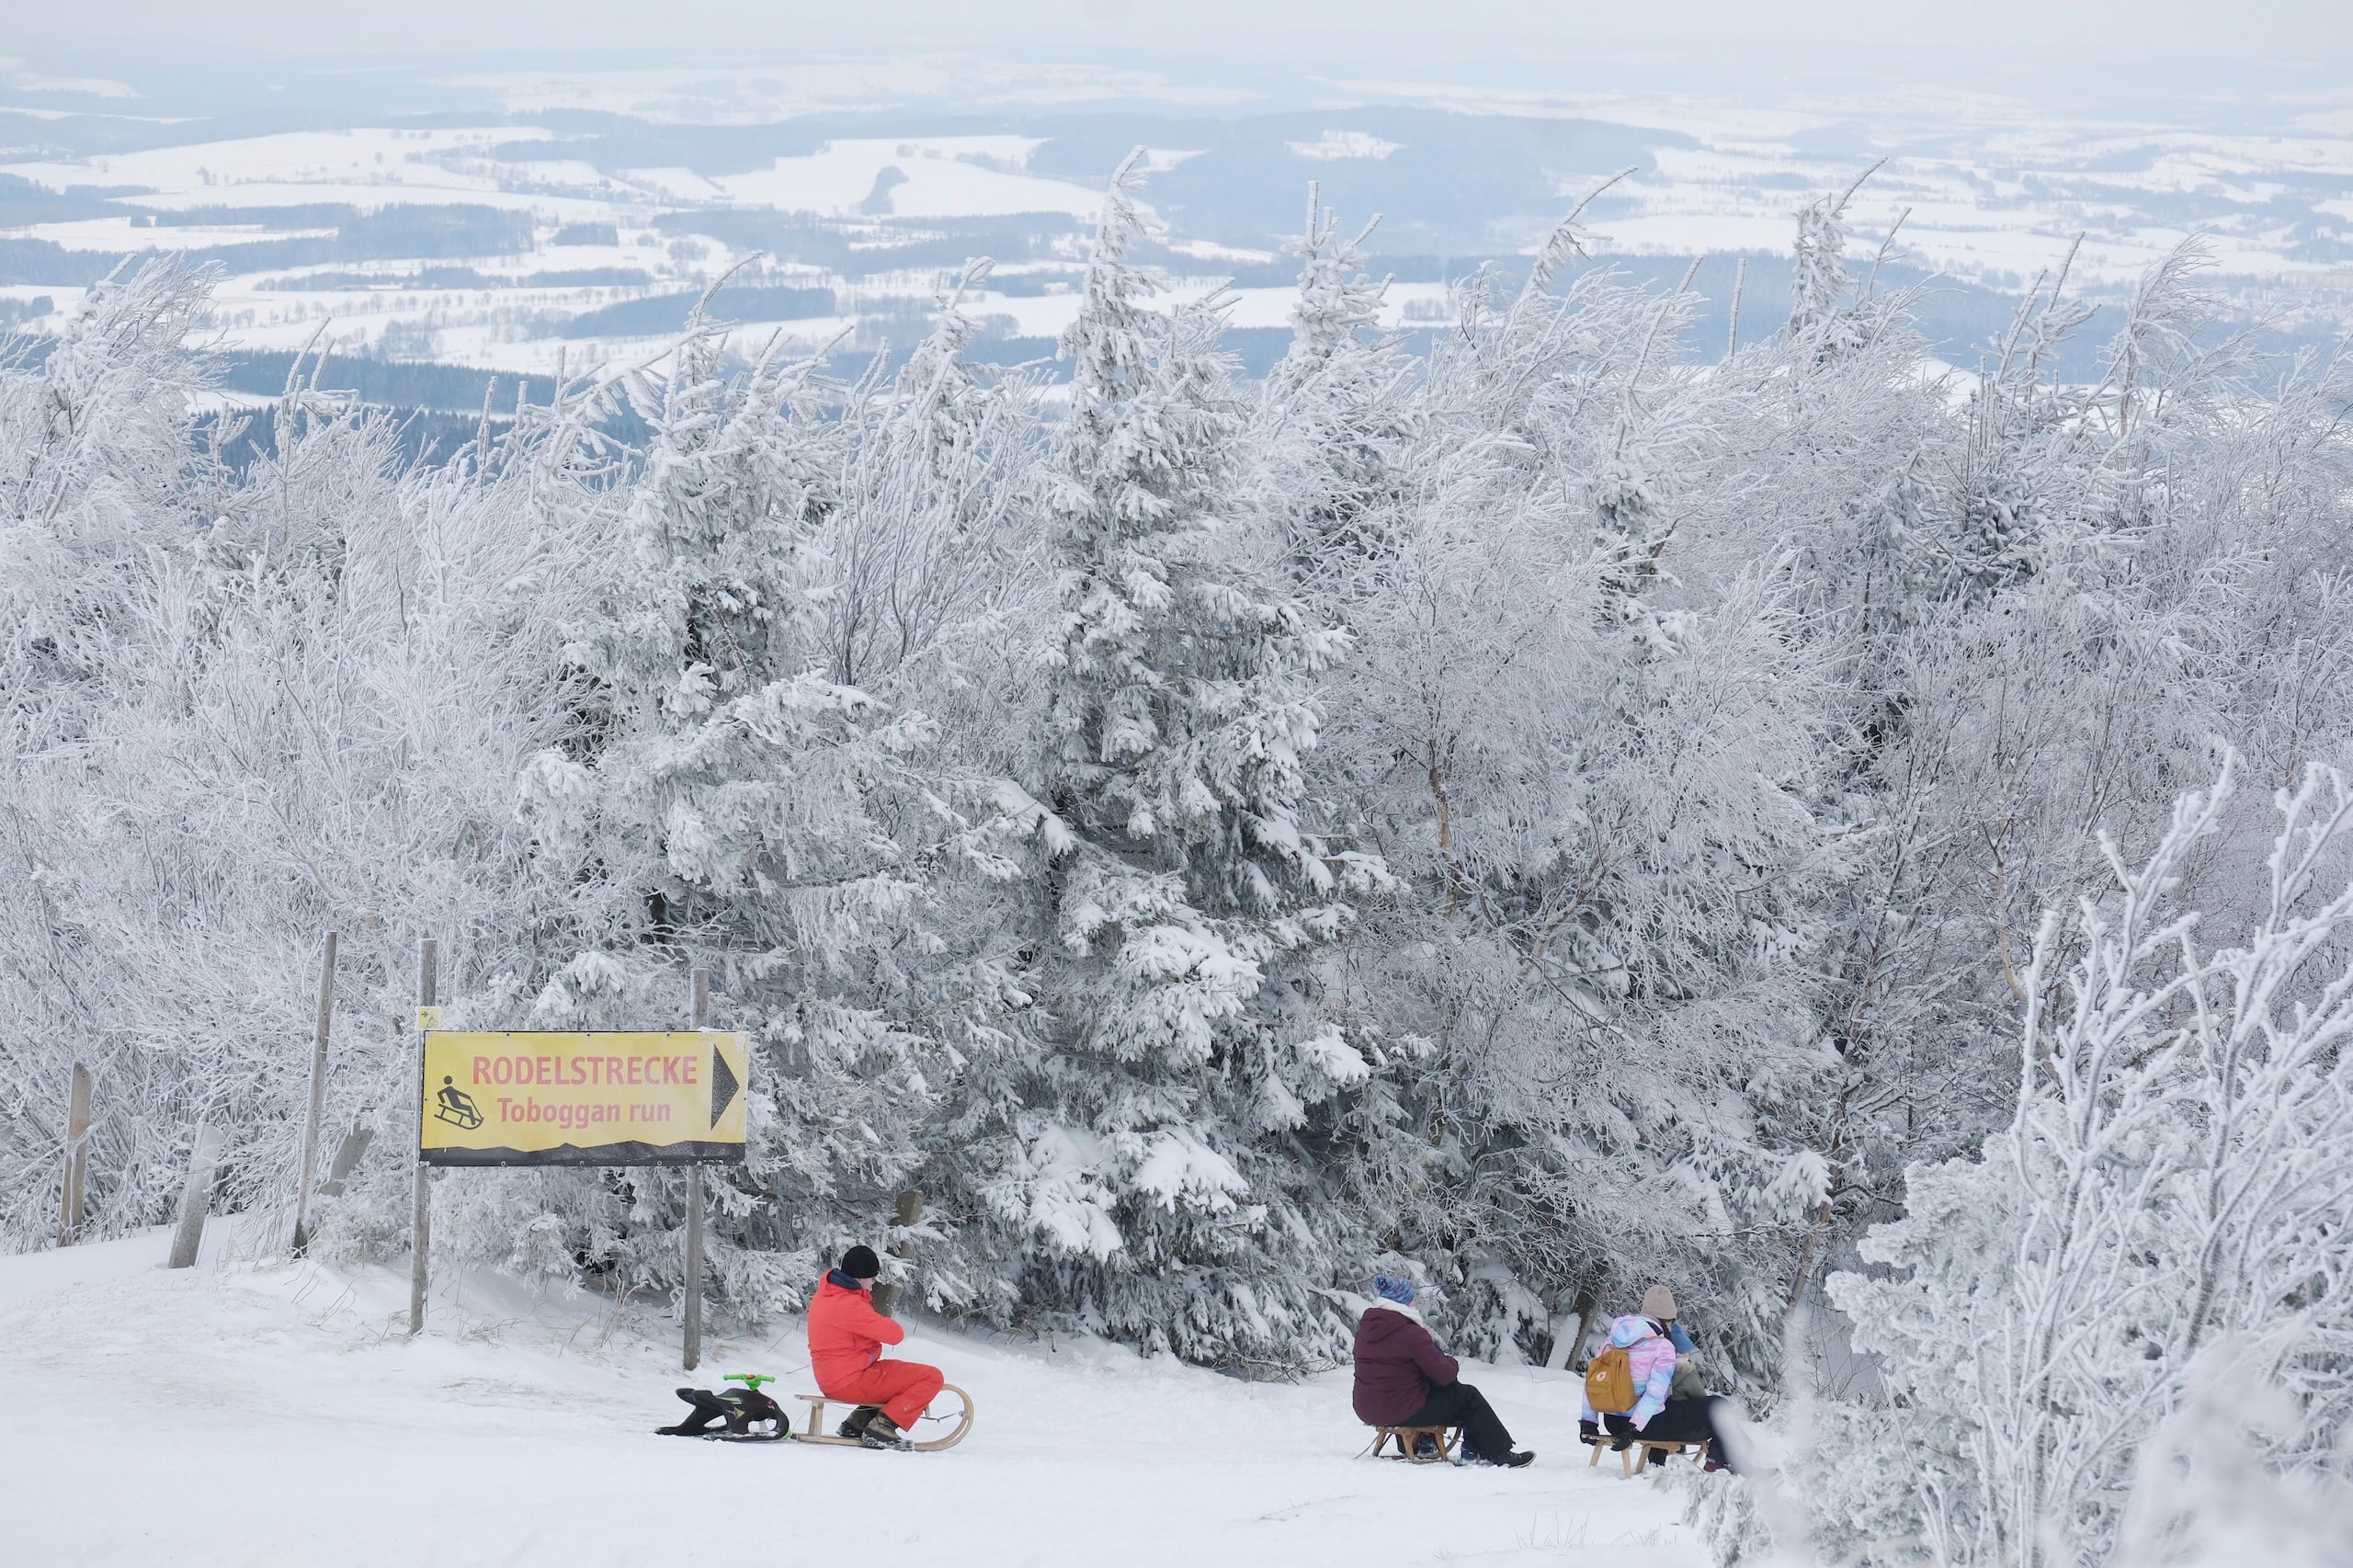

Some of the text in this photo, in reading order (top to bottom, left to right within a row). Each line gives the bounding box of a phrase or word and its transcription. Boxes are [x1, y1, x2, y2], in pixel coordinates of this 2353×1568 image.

[472, 1056, 698, 1085] RODELSTRECKE
[496, 1097, 671, 1129] Toboggan run
